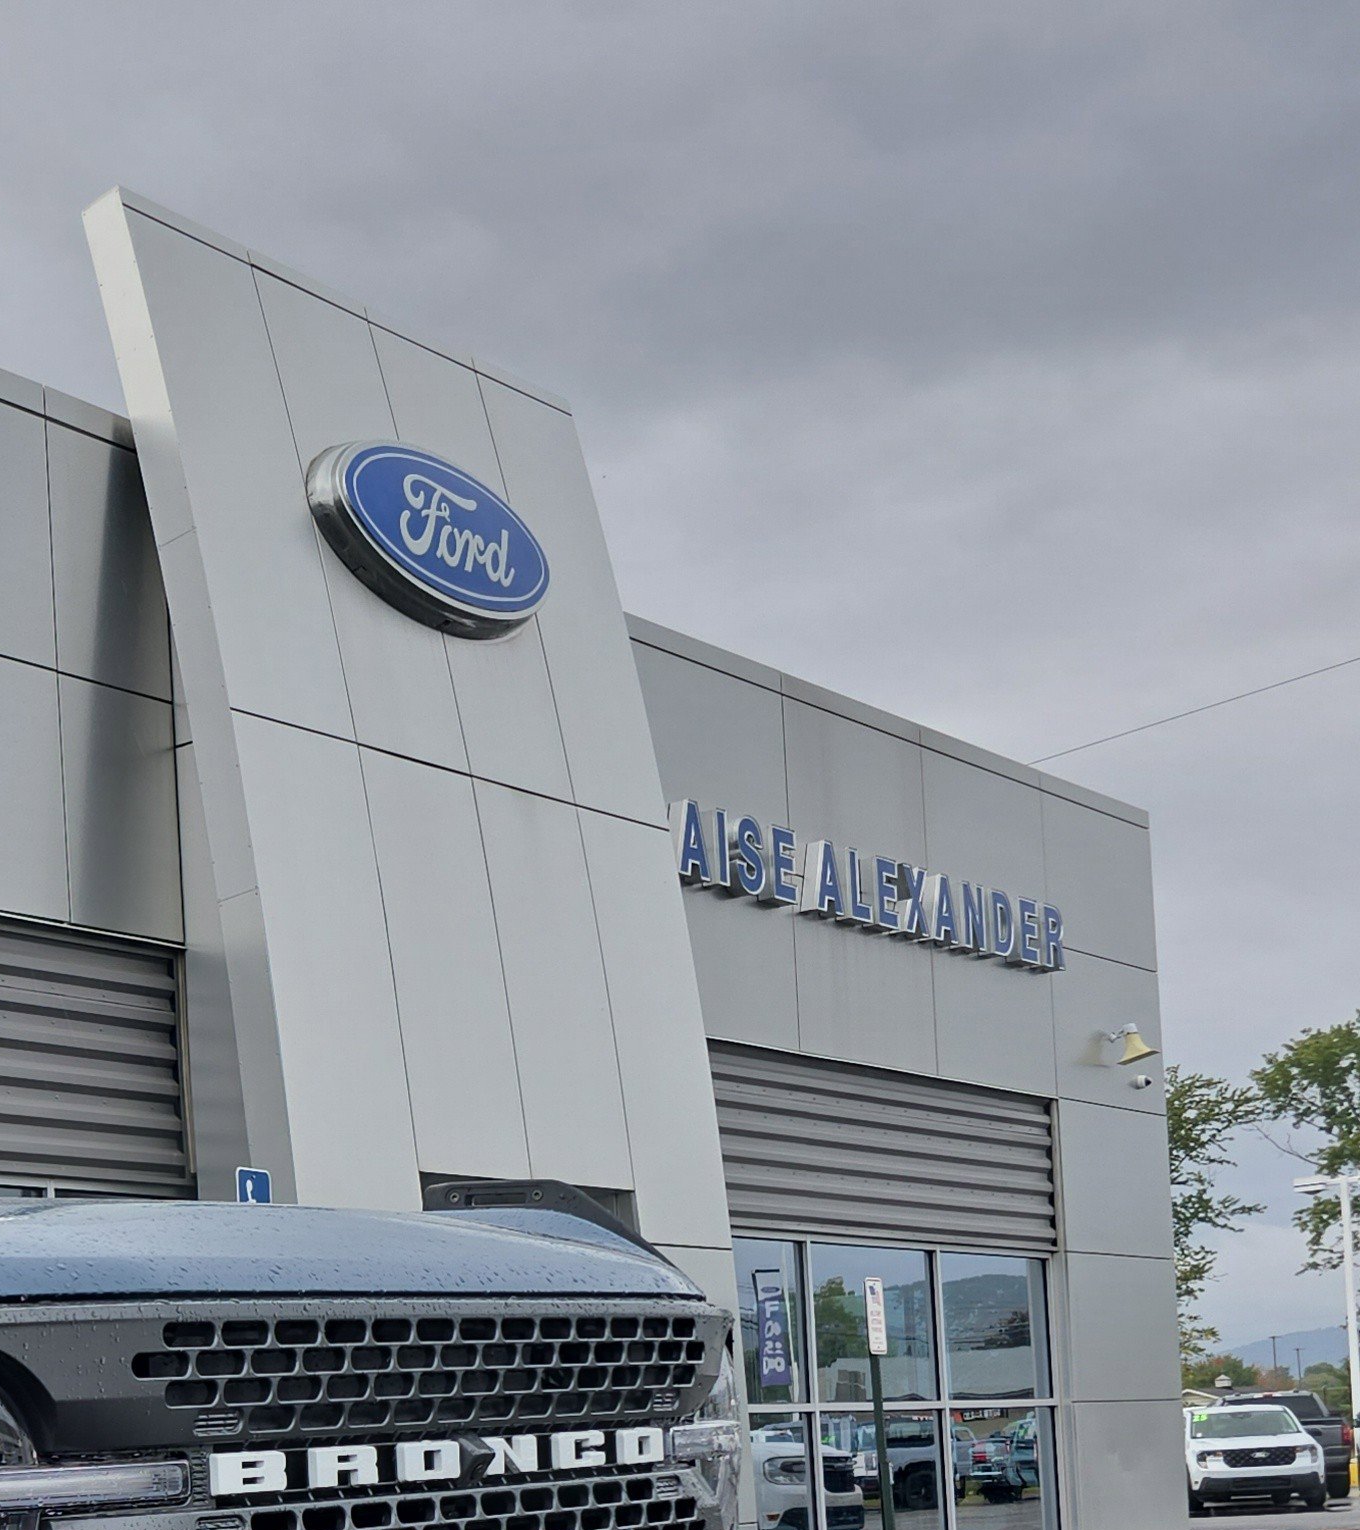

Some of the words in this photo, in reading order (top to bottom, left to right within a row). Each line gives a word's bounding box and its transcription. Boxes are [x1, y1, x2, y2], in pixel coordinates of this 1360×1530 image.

[399, 473, 515, 588] Ford
[813, 839, 1066, 971] ALEXANDER
[209, 1426, 664, 1496] BRONCO
